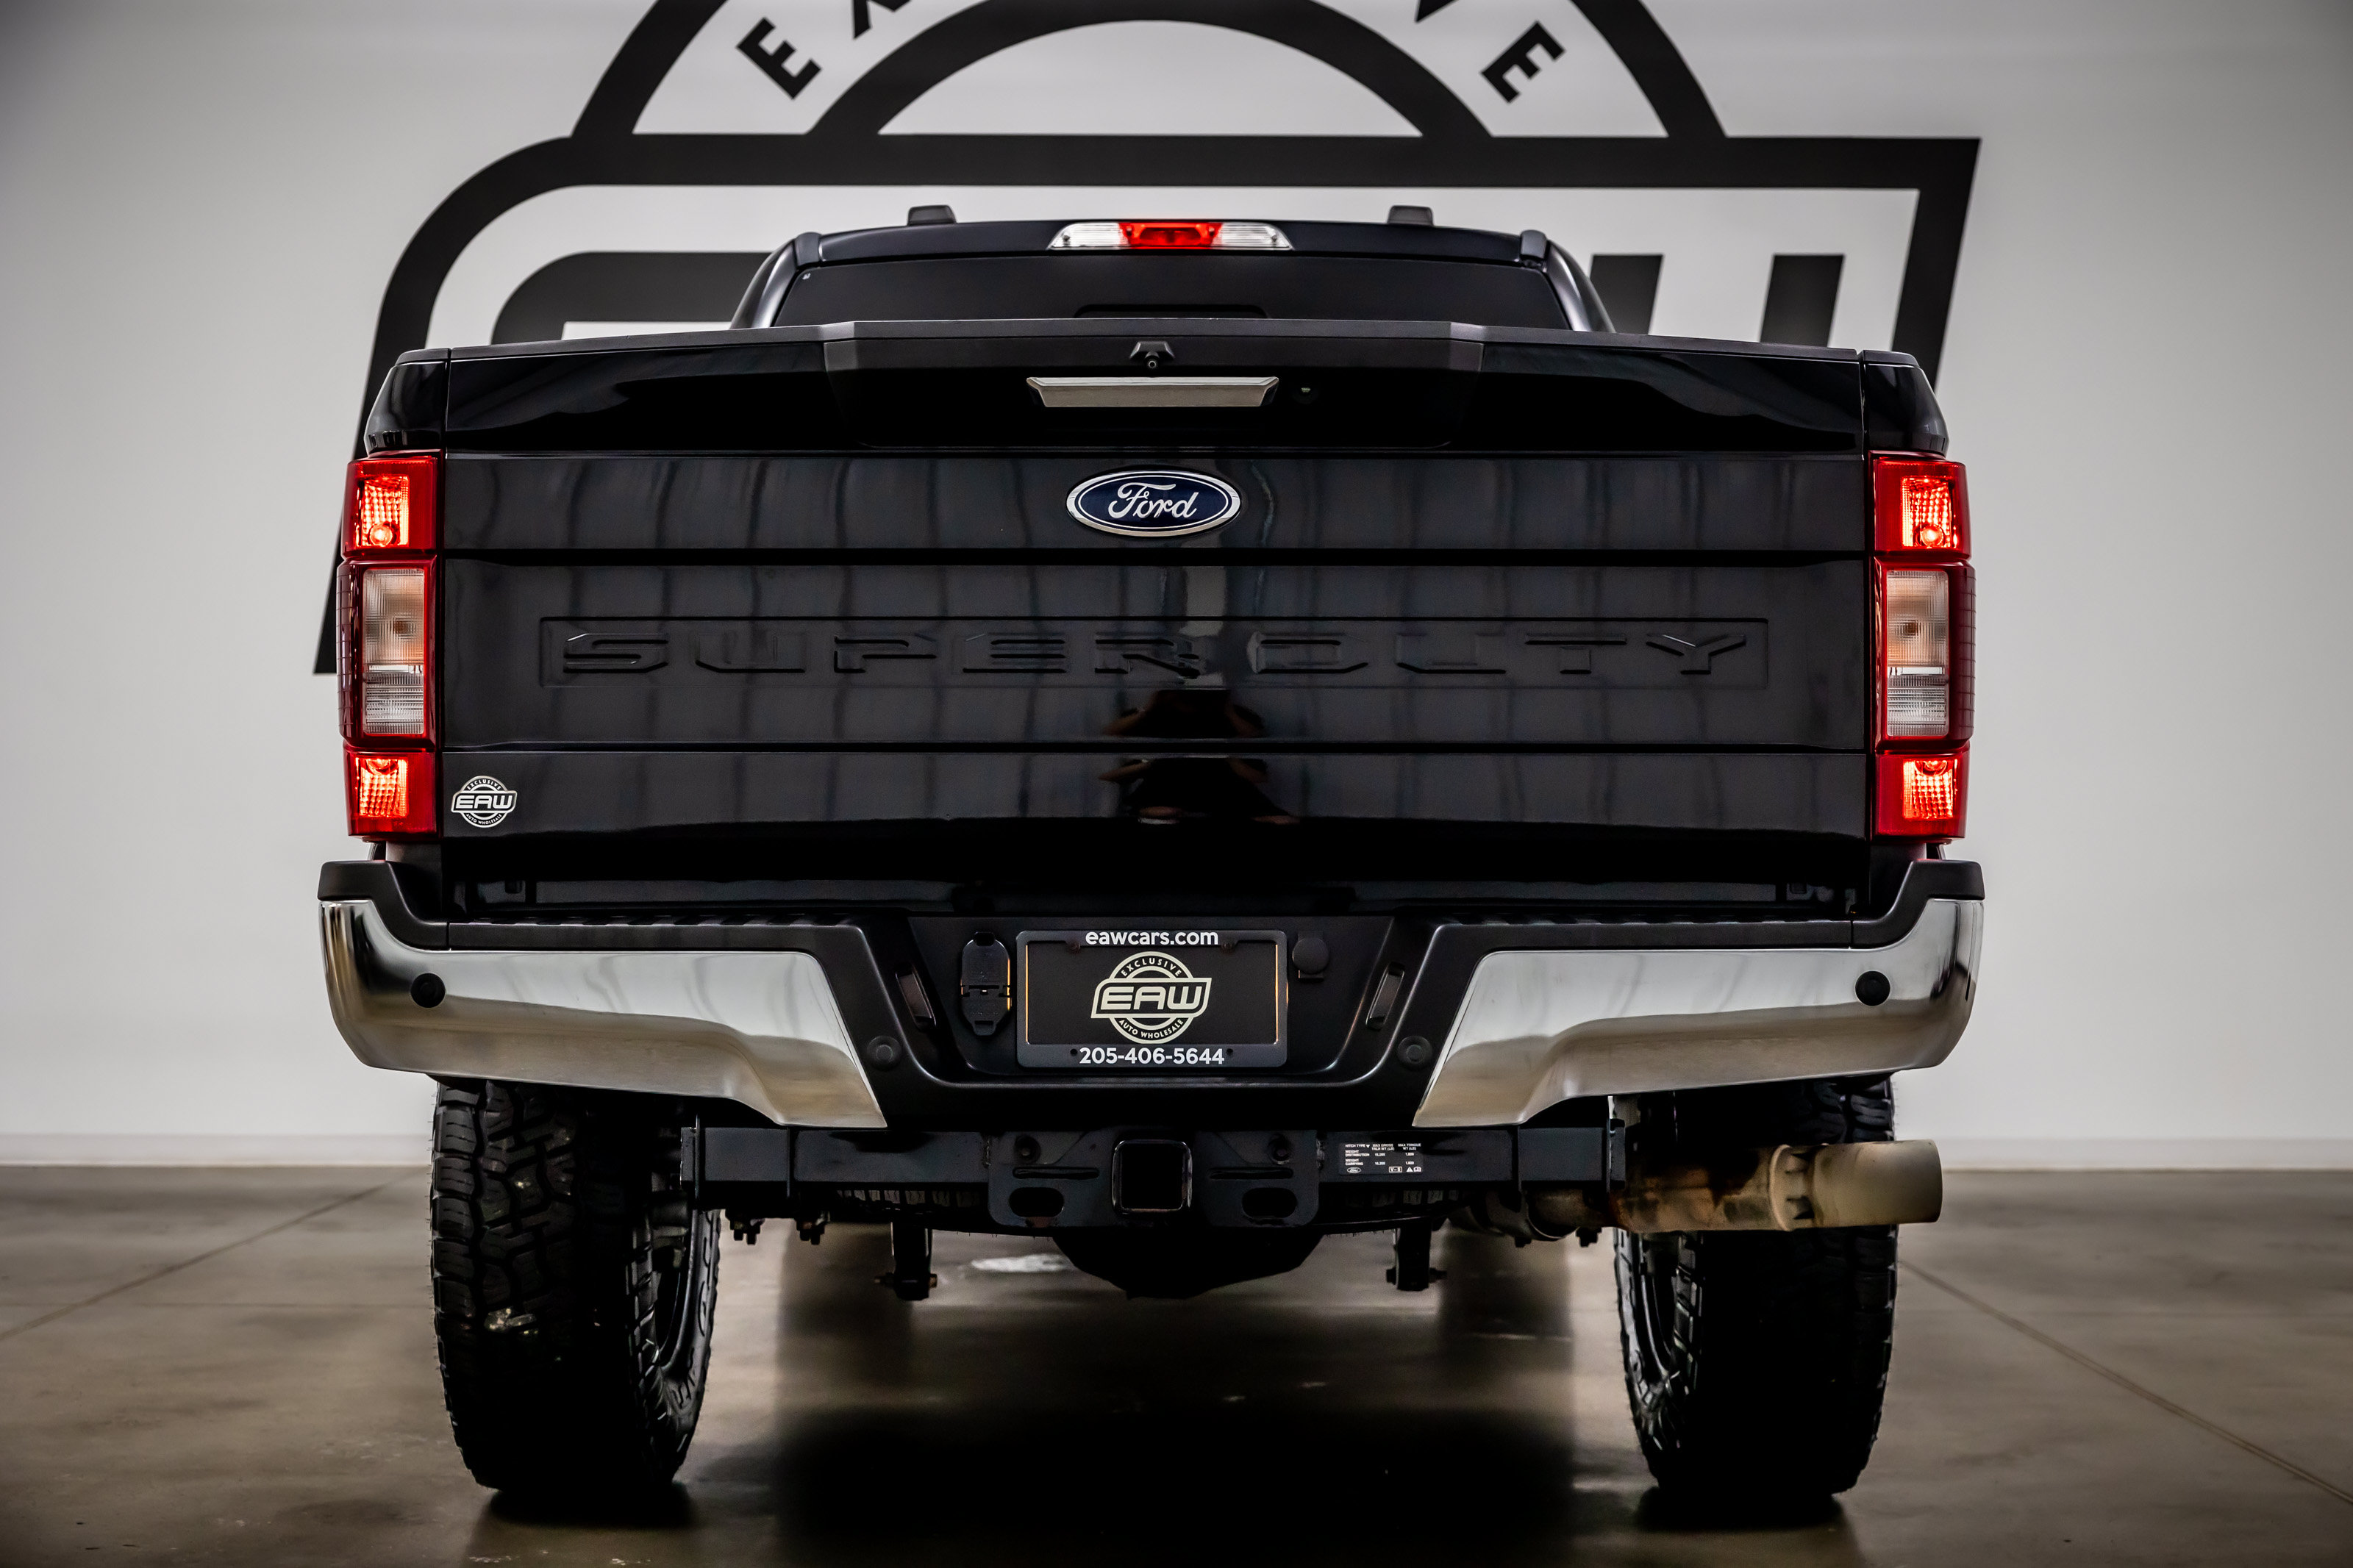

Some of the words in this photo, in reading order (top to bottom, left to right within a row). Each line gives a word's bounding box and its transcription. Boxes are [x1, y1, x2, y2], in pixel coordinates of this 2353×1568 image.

[1108, 482, 1199, 518] Ford
[563, 631, 1201, 674] SUPER
[1246, 631, 1746, 675] DUTY
[467, 779, 501, 790] EXCLUSIVE
[455, 795, 513, 809] EAW
[465, 813, 477, 823] AUTO
[478, 814, 502, 825] WHOLESALE
[1085, 931, 1218, 945] eawcars.com
[1121, 958, 1182, 976] EXCLUSIVE
[1101, 986, 1202, 1010] EAW
[1118, 1020, 1138, 1035] AUTO
[1140, 1019, 1184, 1039] WHOLESALE
[1079, 1047, 1224, 1064] 205-406-5644
